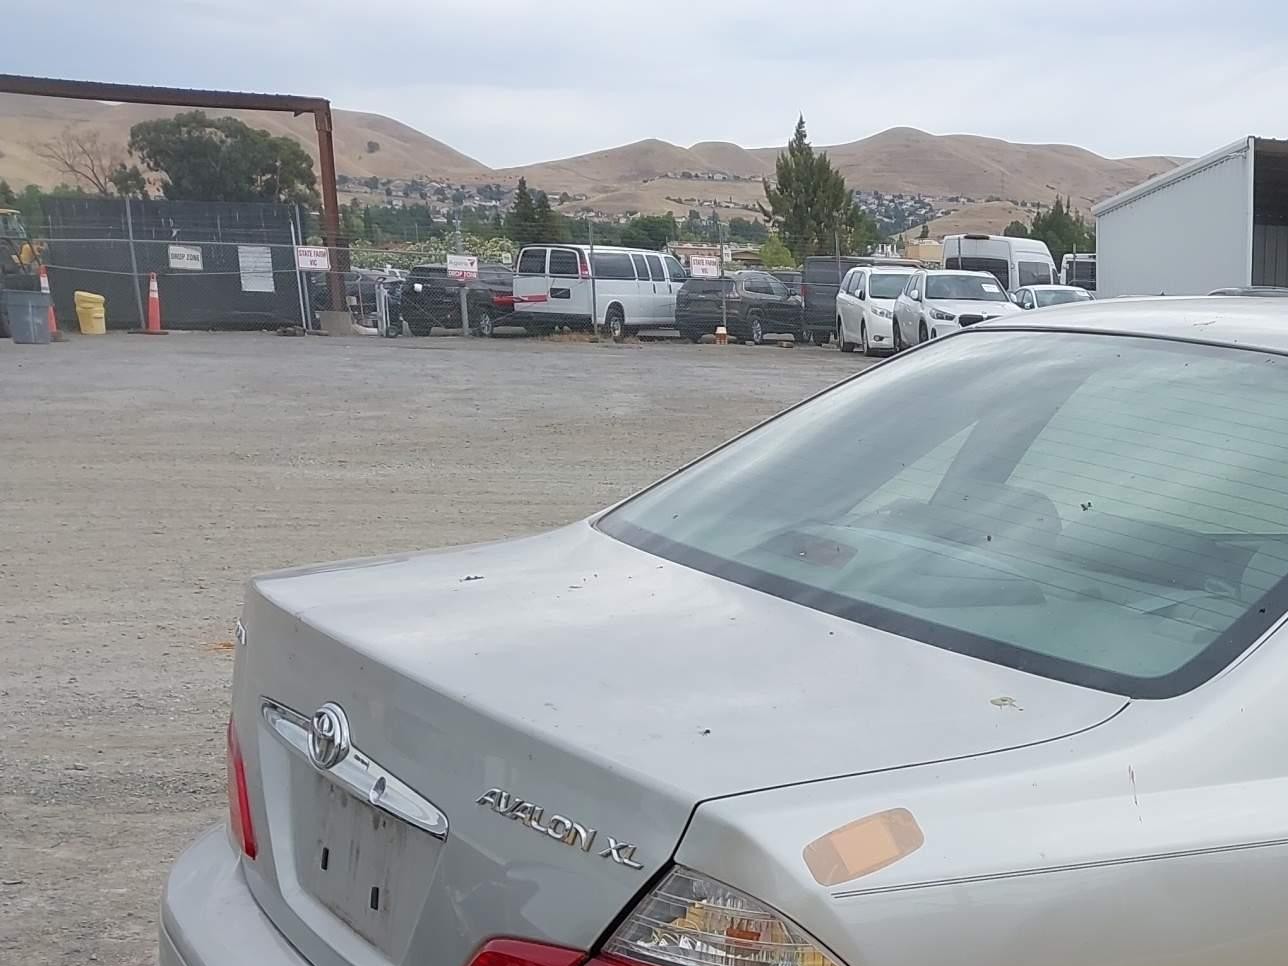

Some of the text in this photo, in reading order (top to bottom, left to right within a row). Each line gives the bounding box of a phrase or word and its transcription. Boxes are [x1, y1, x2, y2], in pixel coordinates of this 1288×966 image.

[298, 249, 326, 258] STATE FARM
[475, 787, 645, 870] AVALON XL
